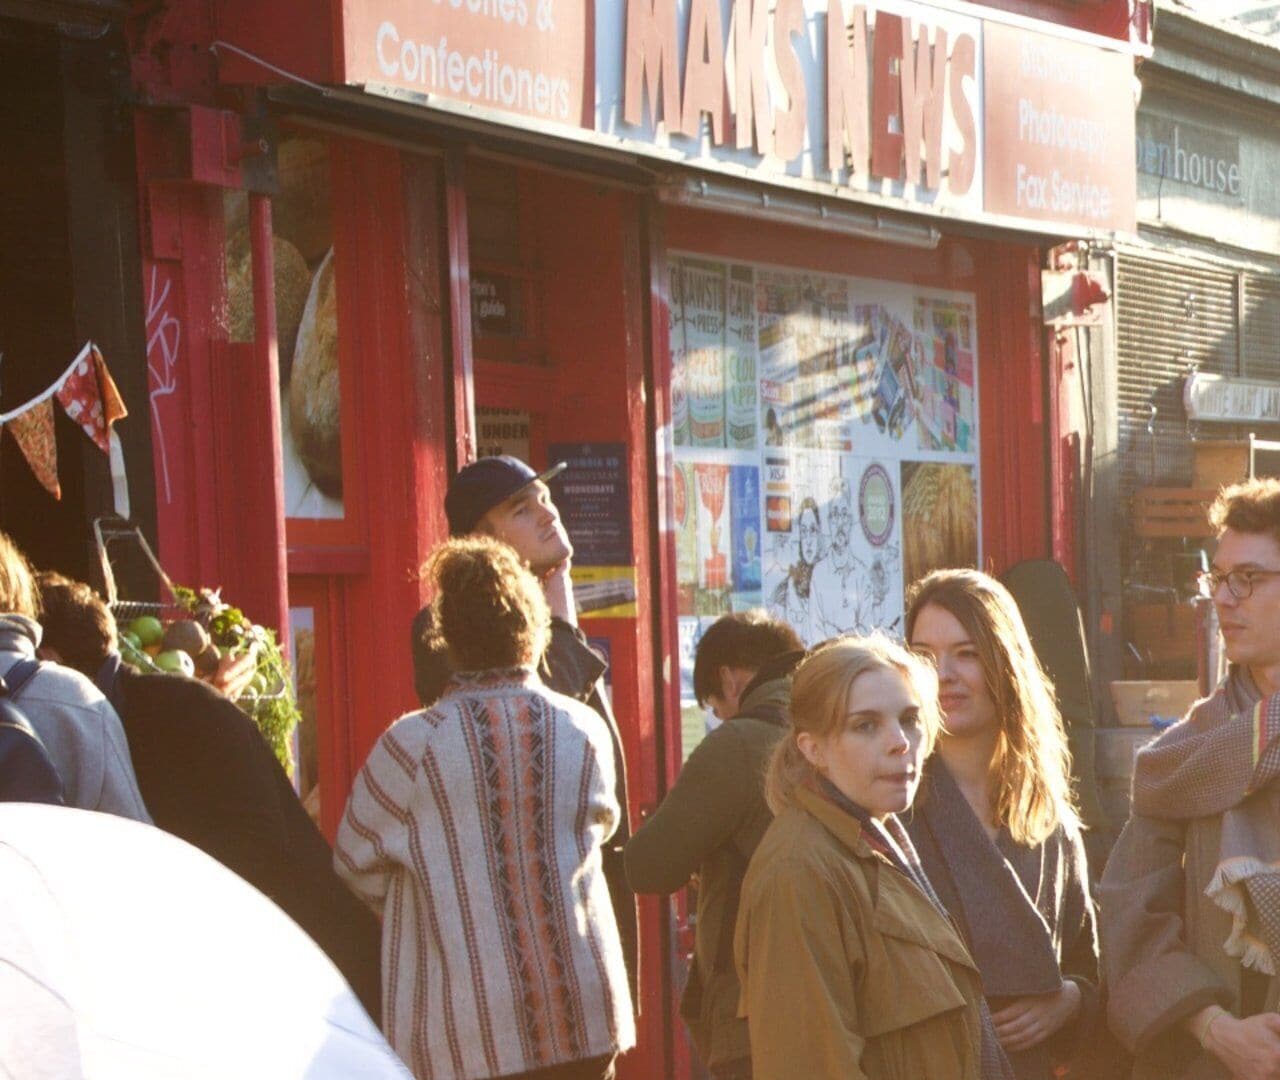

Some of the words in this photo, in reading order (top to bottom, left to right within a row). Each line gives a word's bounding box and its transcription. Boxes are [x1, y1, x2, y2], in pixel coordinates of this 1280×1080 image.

[376, 21, 569, 117] Confectioners
[624, 0, 808, 162] MAKS
[827, 0, 977, 196] NEWS
[1016, 163, 1048, 210] Fax
[1051, 167, 1112, 220] Service
